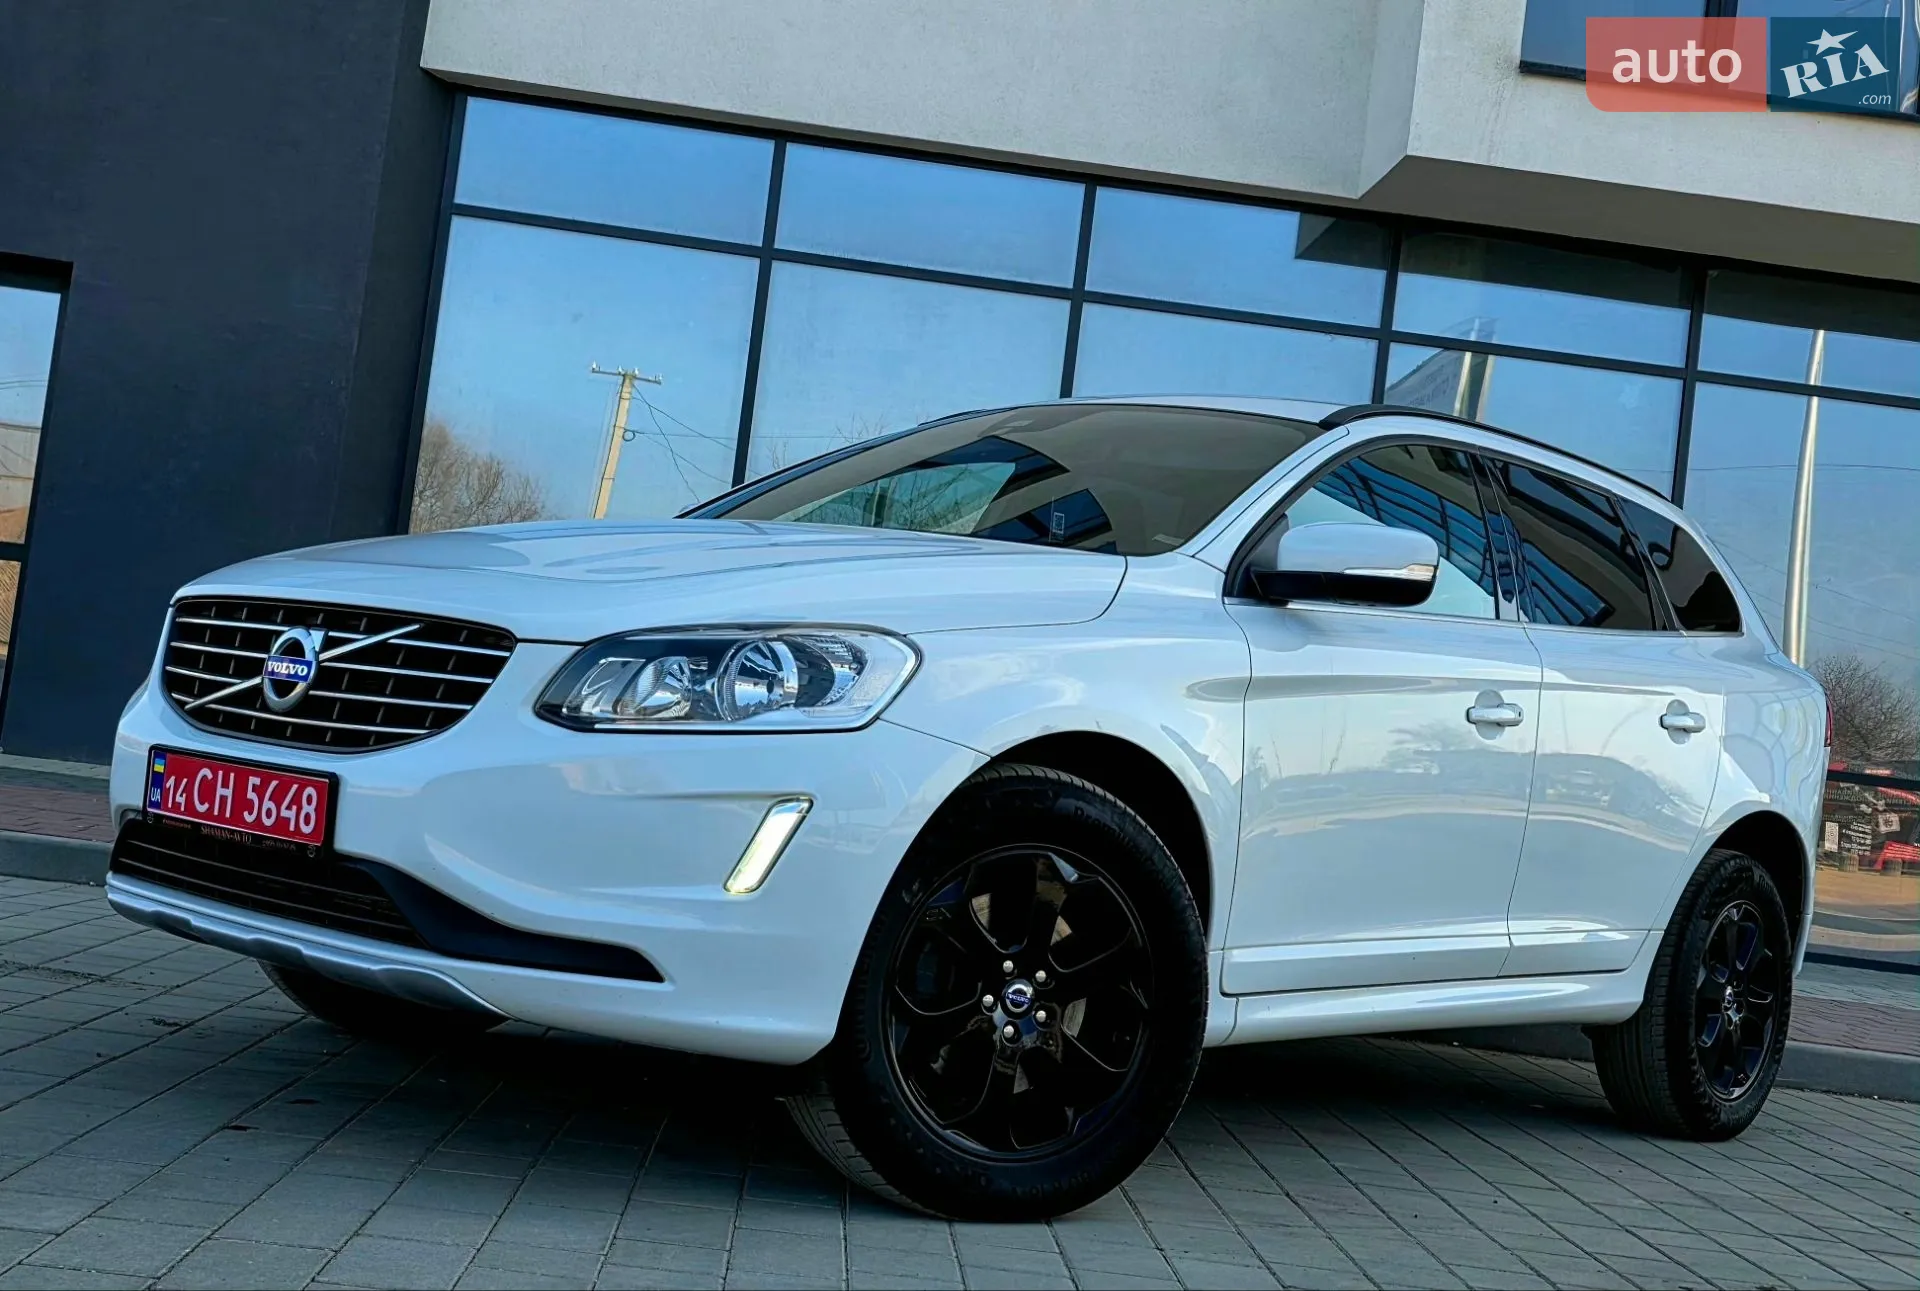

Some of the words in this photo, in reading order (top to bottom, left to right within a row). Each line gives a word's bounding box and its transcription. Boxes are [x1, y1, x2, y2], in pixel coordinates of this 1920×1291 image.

[267, 661, 308, 676] VOLVO
[151, 787, 161, 803] UA
[166, 775, 188, 812] 14
[193, 767, 235, 818] CH
[244, 776, 317, 834] 5648
